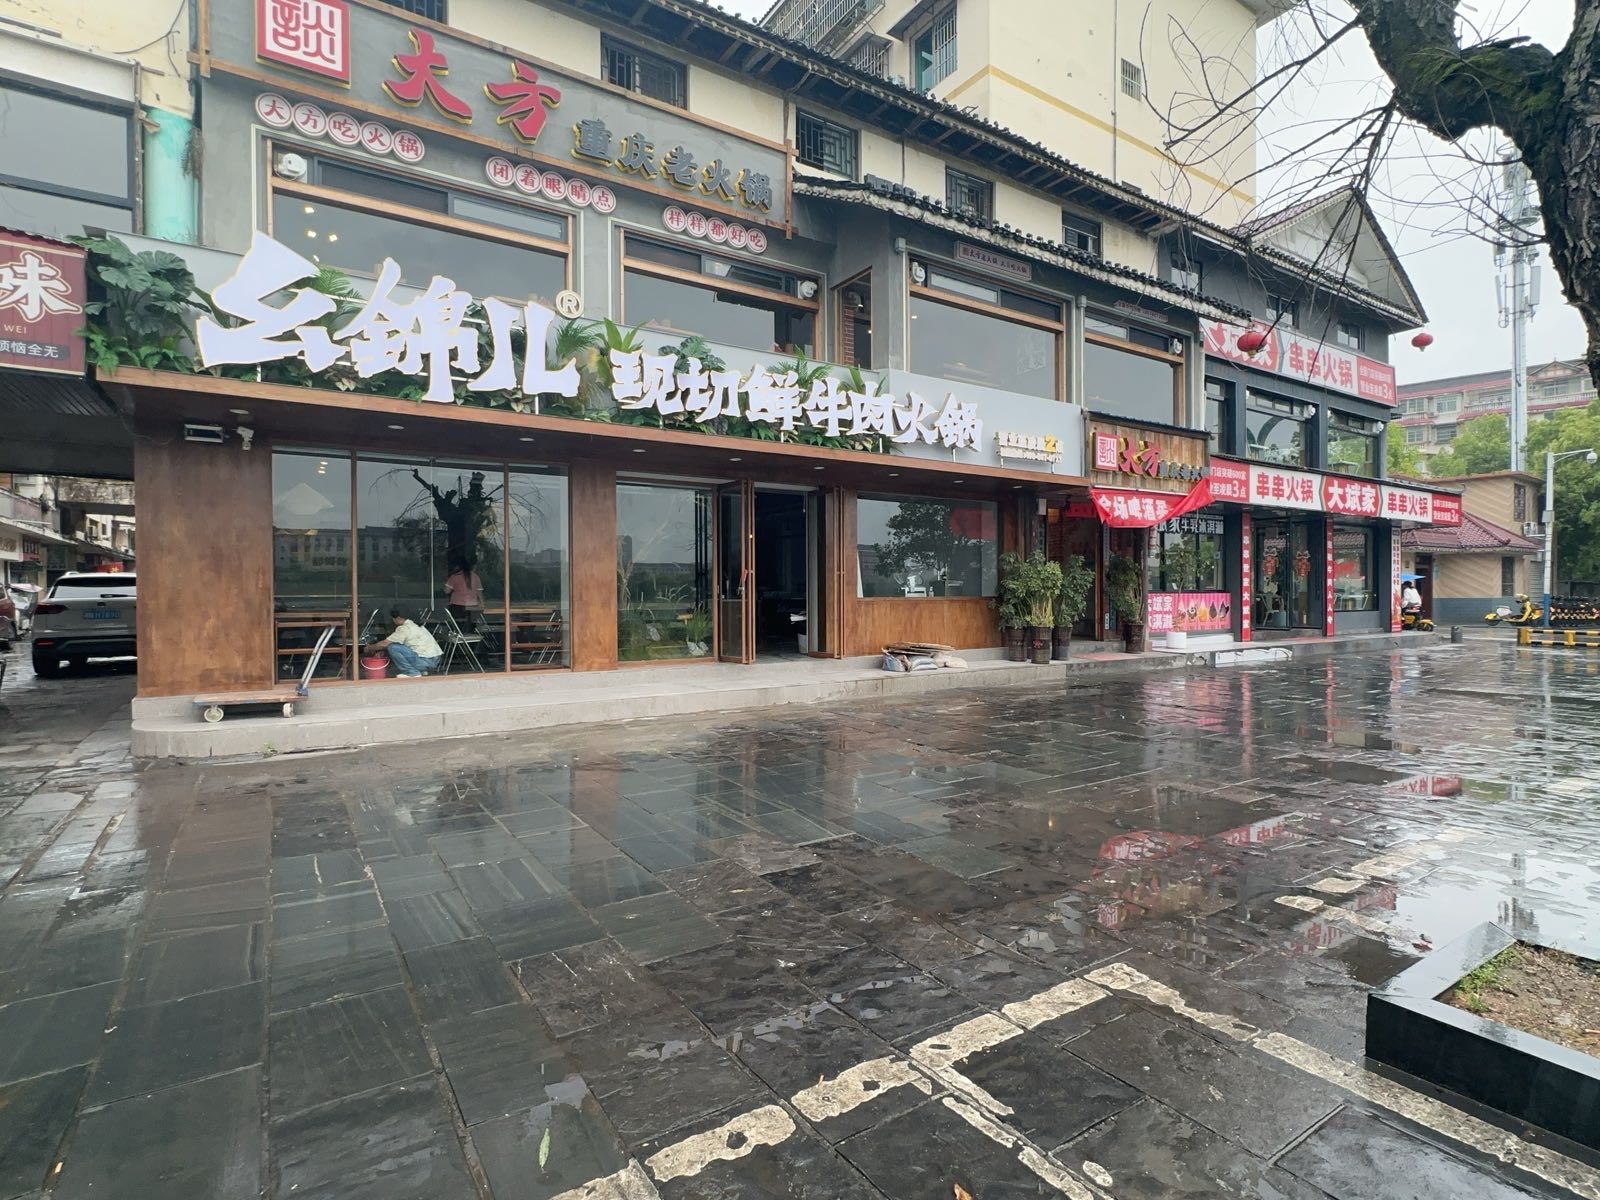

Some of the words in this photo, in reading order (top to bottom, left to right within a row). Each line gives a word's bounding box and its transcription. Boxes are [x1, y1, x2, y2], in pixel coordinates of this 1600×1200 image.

[381, 26, 563, 145] 大方
[260, 96, 421, 159] 大方吃火锅
[490, 160, 613, 209] 闭着眼睛点
[571, 118, 773, 213] 重庆老火锅
[666, 208, 765, 249] 样样都好吃
[4, 324, 27, 334] WEI
[1289, 341, 1353, 389] 串串火锅
[1117, 436, 1162, 478] 大方
[1256, 472, 1314, 503] 串串火锅
[1327, 480, 1376, 513] 大斌家
[1387, 491, 1429, 517] 串串火锅
